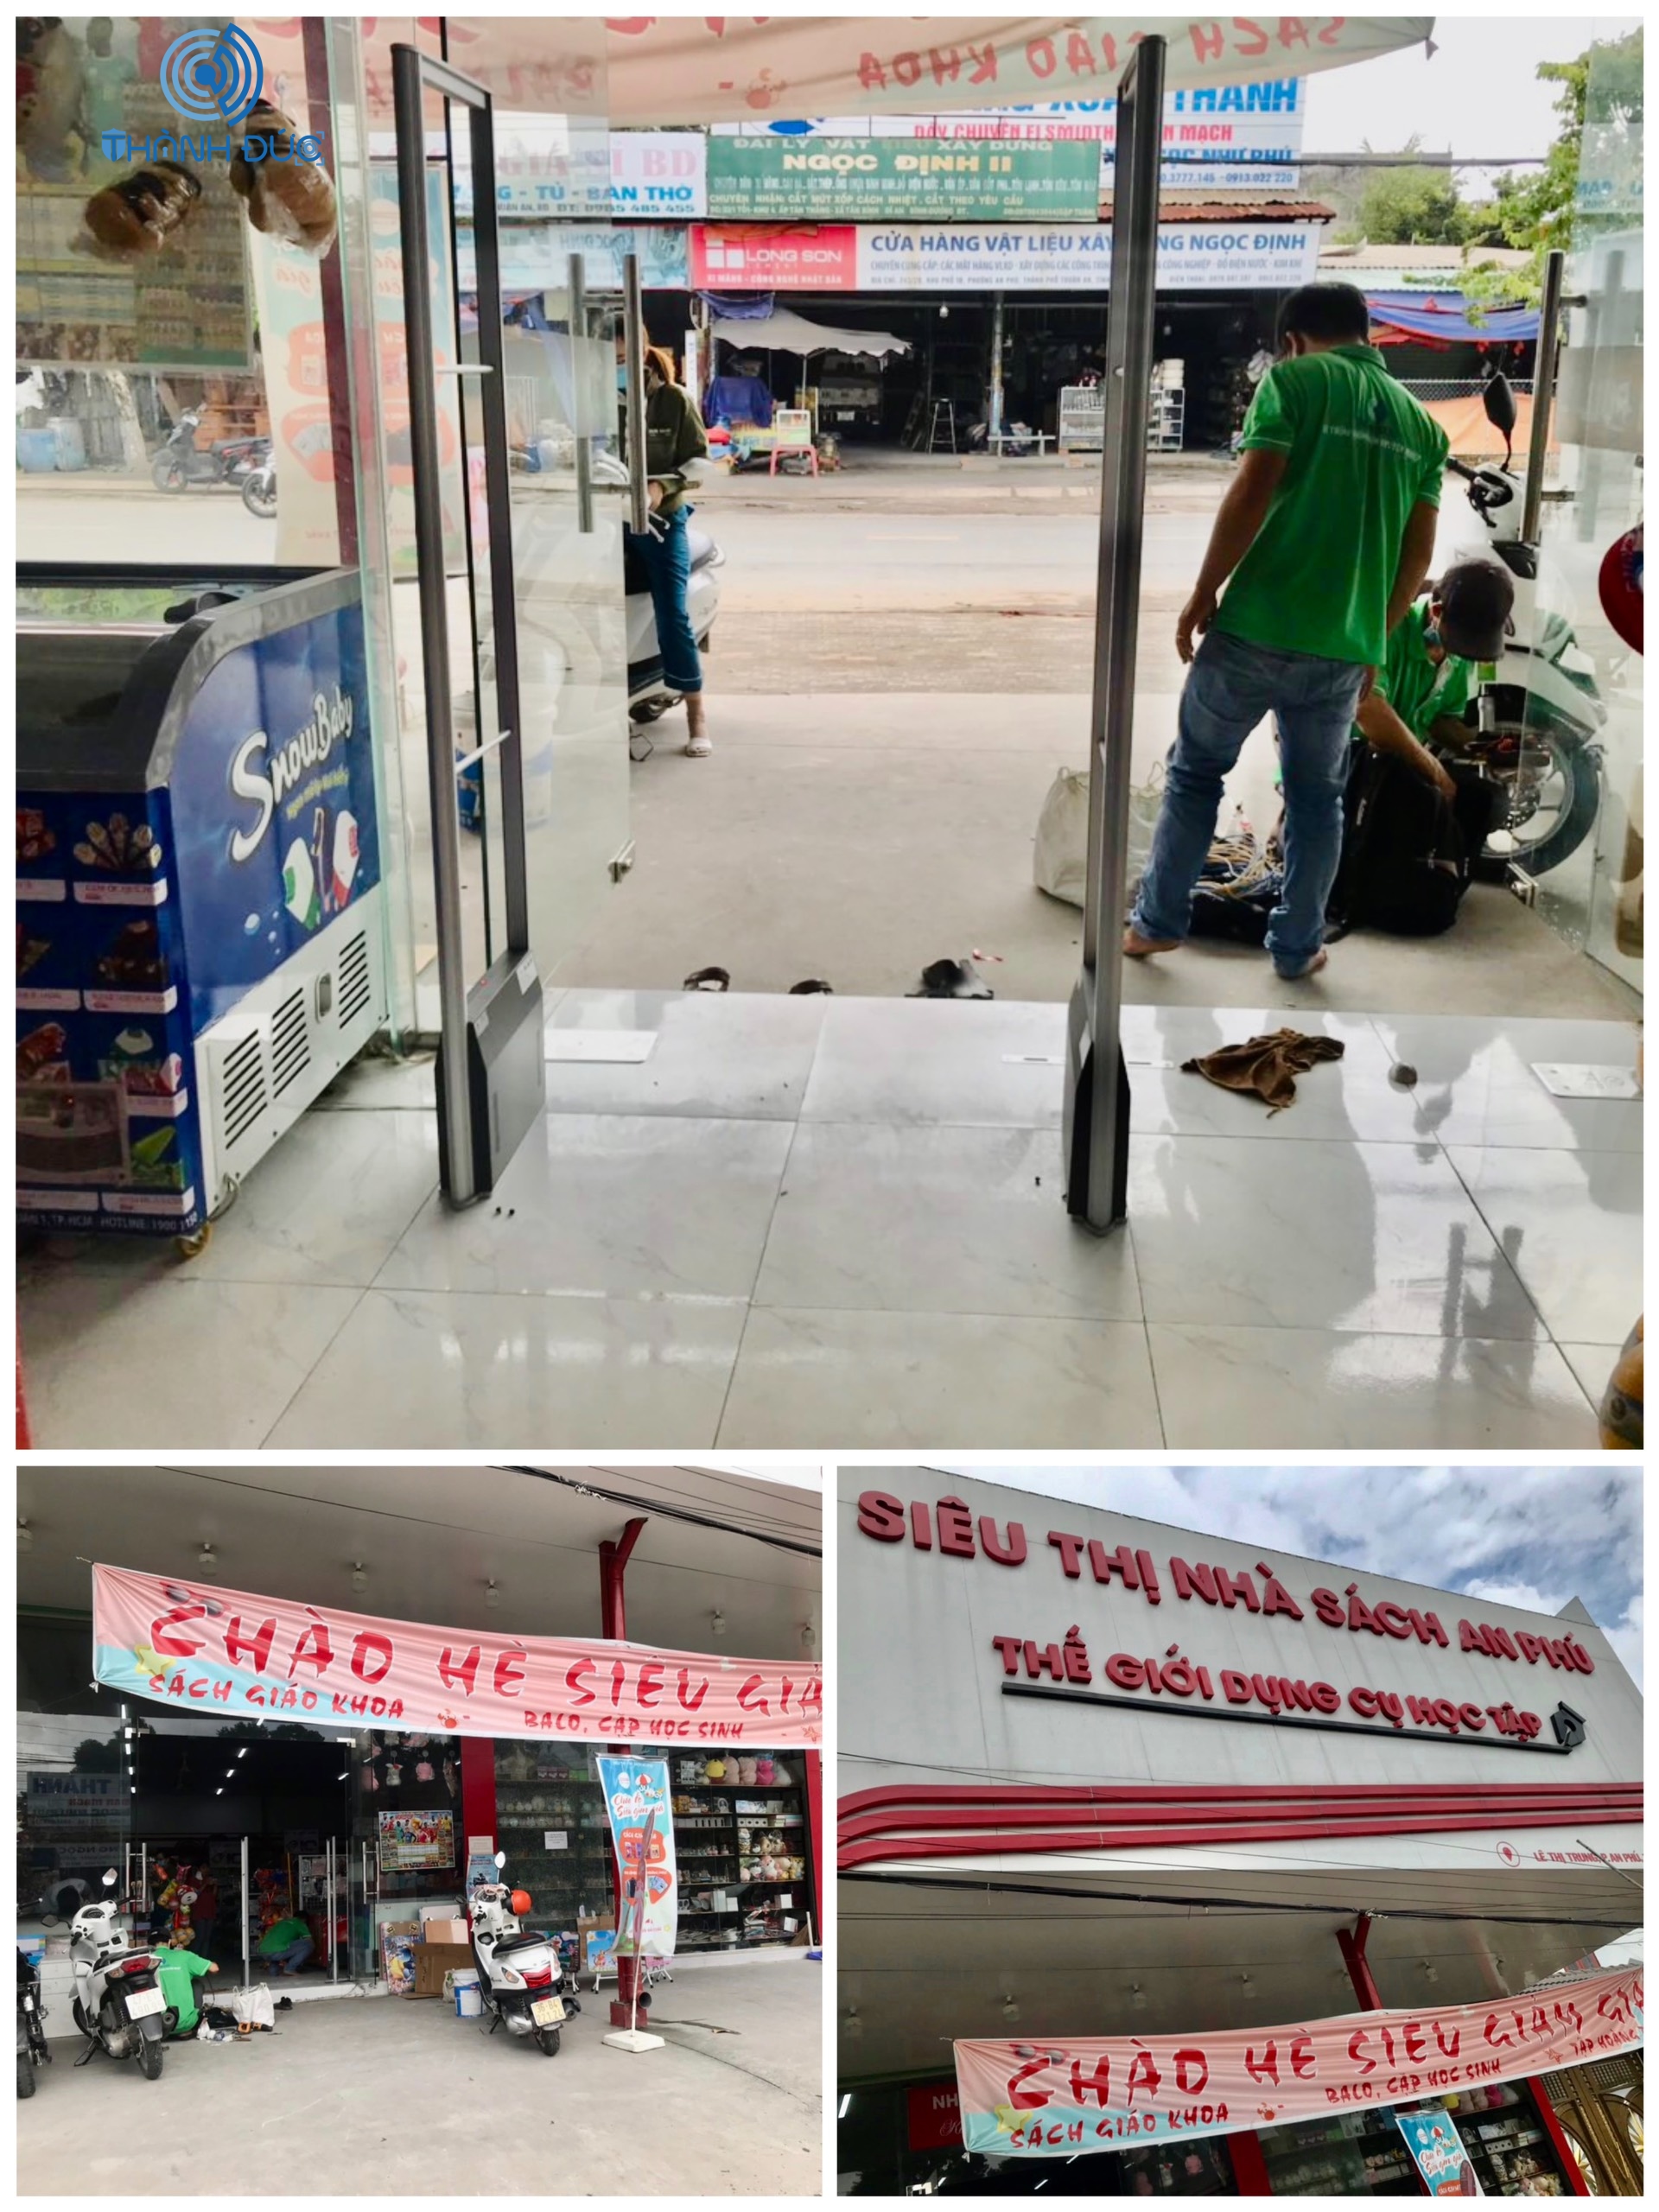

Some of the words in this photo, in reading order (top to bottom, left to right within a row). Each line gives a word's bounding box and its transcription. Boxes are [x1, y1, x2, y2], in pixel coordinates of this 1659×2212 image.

[642, 149, 697, 176] BD
[783, 155, 878, 175] NGỌC
[894, 155, 980, 175] ĐỊNH
[989, 156, 1012, 172] II
[747, 250, 797, 262] LONG
[871, 231, 914, 251] CỬA
[919, 232, 980, 251] HÀNG
[985, 232, 1023, 256] VẬT
[1028, 232, 1073, 256] LIỆU
[1190, 234, 1249, 254] NGỌC
[1254, 233, 1306, 253] ĐỊNH
[857, 1491, 1028, 1566] SIÊU
[1047, 1529, 1161, 1605] THỊ
[1169, 1557, 1304, 1621] NHÀ
[1311, 1582, 1449, 1648] SÁCH
[1458, 1618, 1519, 1661] AN
[1514, 1632, 1595, 1675] PHÚ
[151, 1605, 394, 1684] CHÀO
[436, 1639, 528, 1698] HÈ
[993, 1624, 1092, 1683] THẾ
[1105, 1643, 1214, 1700] GIỚI
[1219, 1669, 1341, 1715] DỤNG
[1348, 1686, 1404, 1728] CỤ
[1405, 1694, 1486, 1733] HỌC
[1485, 1701, 1542, 1742] TẬP
[149, 1669, 232, 1702] SÁCH
[245, 1684, 317, 1710] GIÁO
[332, 1693, 404, 1719] KHOA
[650, 1719, 690, 1740] HỌC
[699, 1722, 744, 1739] SINH
[1533, 1849, 1547, 1862] LÊ
[1547, 1852, 1567, 1864] THỊ
[1007, 2037, 1209, 2110] CHÀO
[1243, 2027, 1317, 2088] HÈ
[1009, 2119, 1084, 2149] SÁCH
[1096, 2109, 1156, 2139] GIÁO
[1168, 2102, 1229, 2130] KHOA
[1427, 2066, 1460, 2089] HỌC
[1465, 2058, 1501, 2078] SINH
